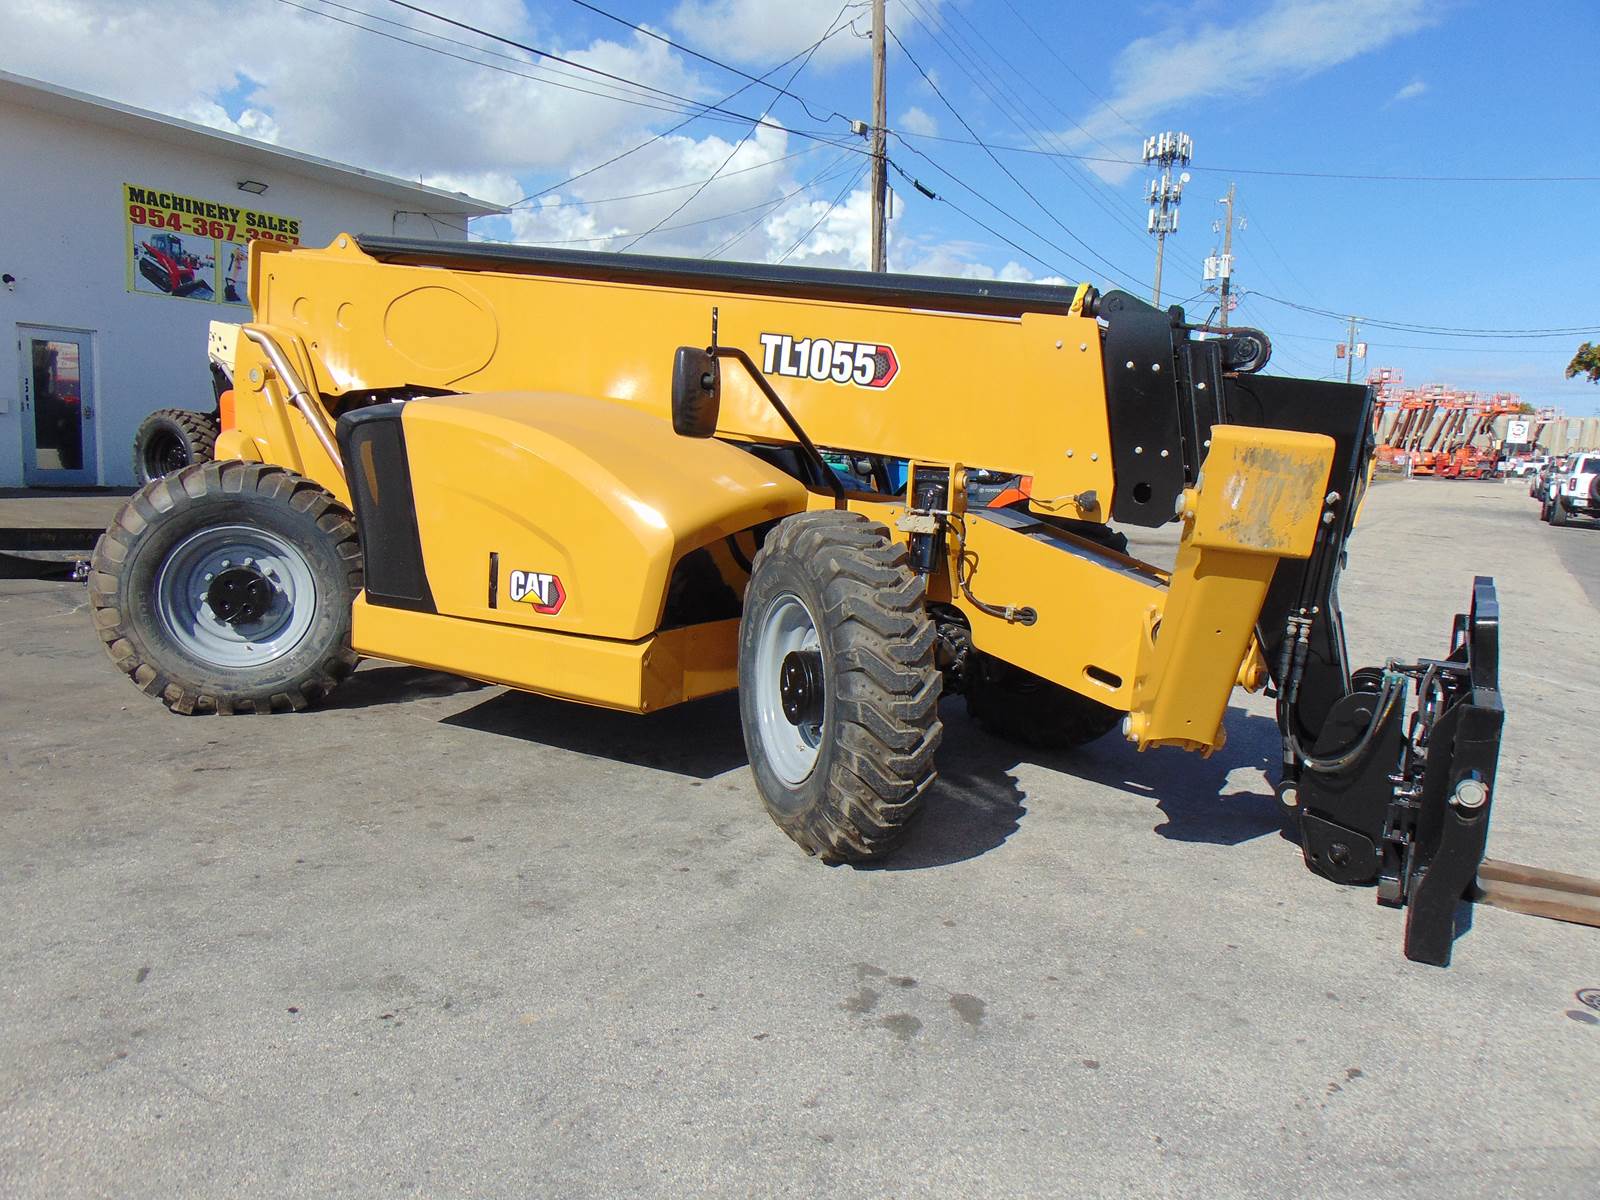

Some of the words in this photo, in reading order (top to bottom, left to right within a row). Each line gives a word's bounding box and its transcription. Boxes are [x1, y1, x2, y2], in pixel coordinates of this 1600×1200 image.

[128, 186, 240, 223] MACHINERY
[245, 212, 299, 235] SALES
[761, 333, 877, 385] TL1055
[510, 570, 553, 605] CAT
